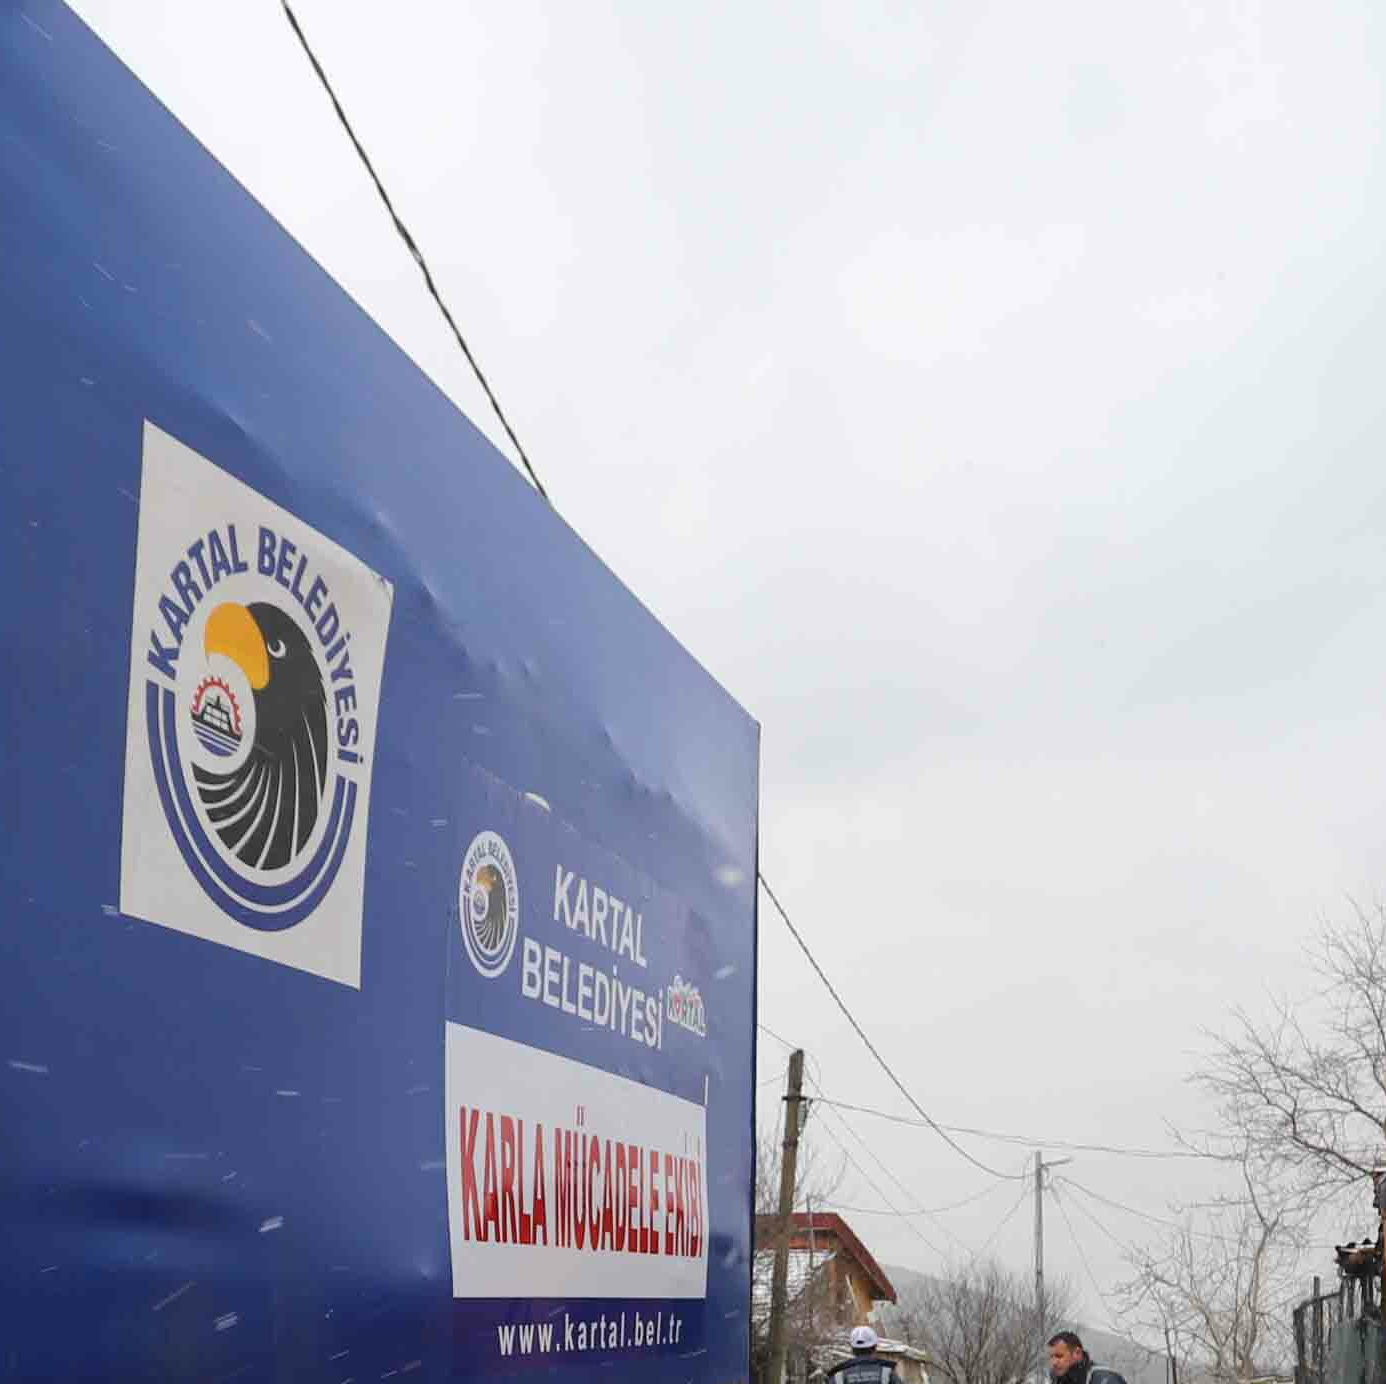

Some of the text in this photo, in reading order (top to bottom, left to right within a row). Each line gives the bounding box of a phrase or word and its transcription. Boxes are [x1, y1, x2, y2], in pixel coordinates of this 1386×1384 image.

[147, 523, 364, 764] KARTAL BELEDİYESİ
[553, 863, 648, 969] KARTAL
[521, 936, 663, 1051] BELEDİYESİ
[459, 1104, 704, 1258] KARLA MÜCADELE EKİBİ
[498, 1312, 682, 1356] www.kartal.bel.tr
